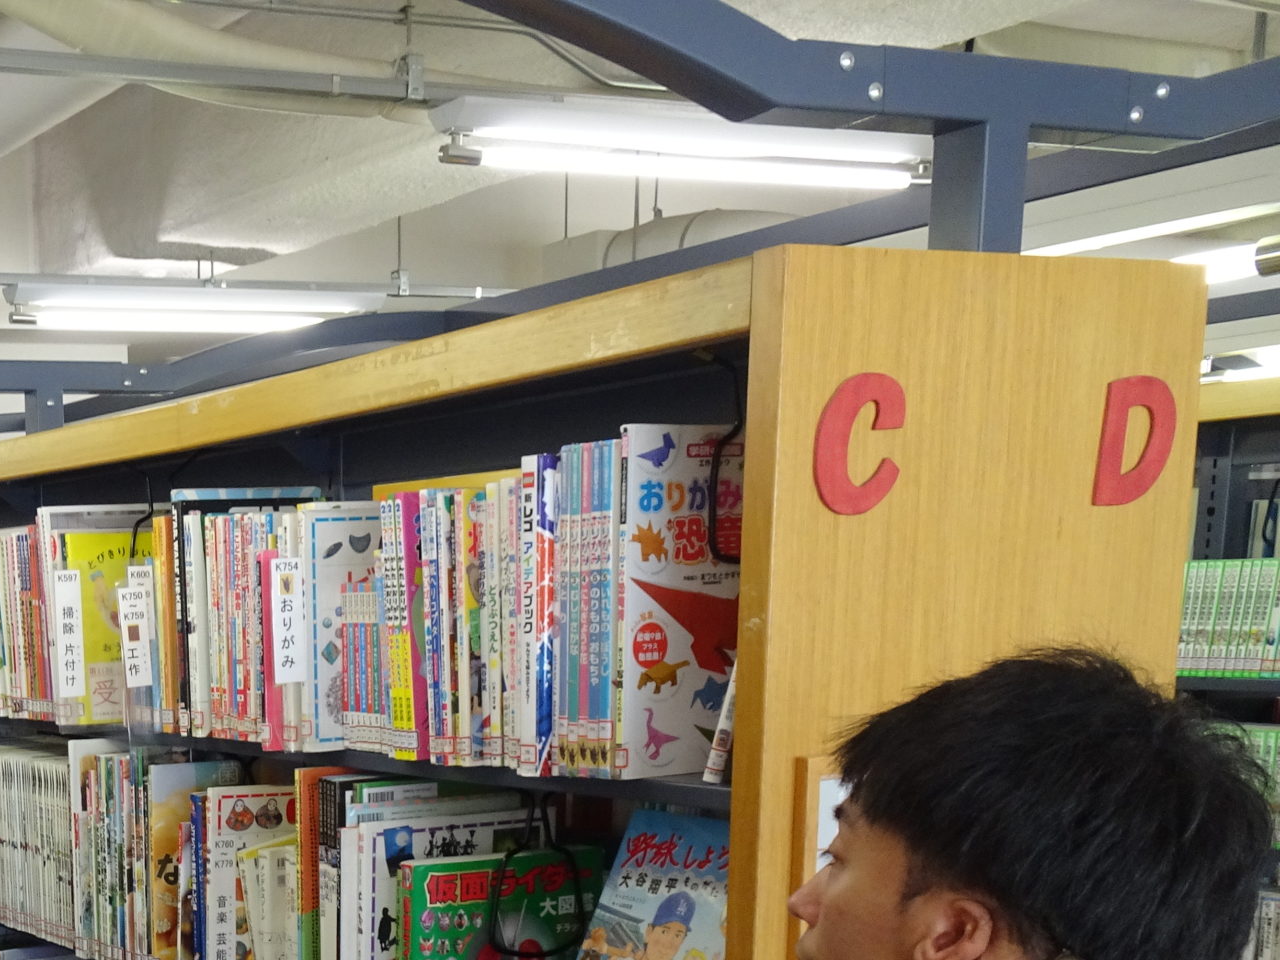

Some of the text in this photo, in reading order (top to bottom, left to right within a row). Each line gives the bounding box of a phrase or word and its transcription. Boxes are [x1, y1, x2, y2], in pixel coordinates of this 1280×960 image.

[813, 372, 906, 516] C
[1092, 375, 1178, 507] D
[57, 573, 78, 583] K597
[275, 562, 299, 573] K754
[121, 591, 144, 602] K750
[523, 541, 533, 634] アイデアブック
[123, 611, 145, 621] K759
[488, 584, 498, 655] どうぶつえん
[62, 606, 77, 687] 掃除 片付け
[279, 596, 297, 670] おりがみ
[127, 647, 141, 677] 工作
[214, 840, 234, 849] K760
[214, 859, 234, 869] K779
[425, 862, 594, 905] 仮面ライダー
[215, 894, 228, 925] 音楽
